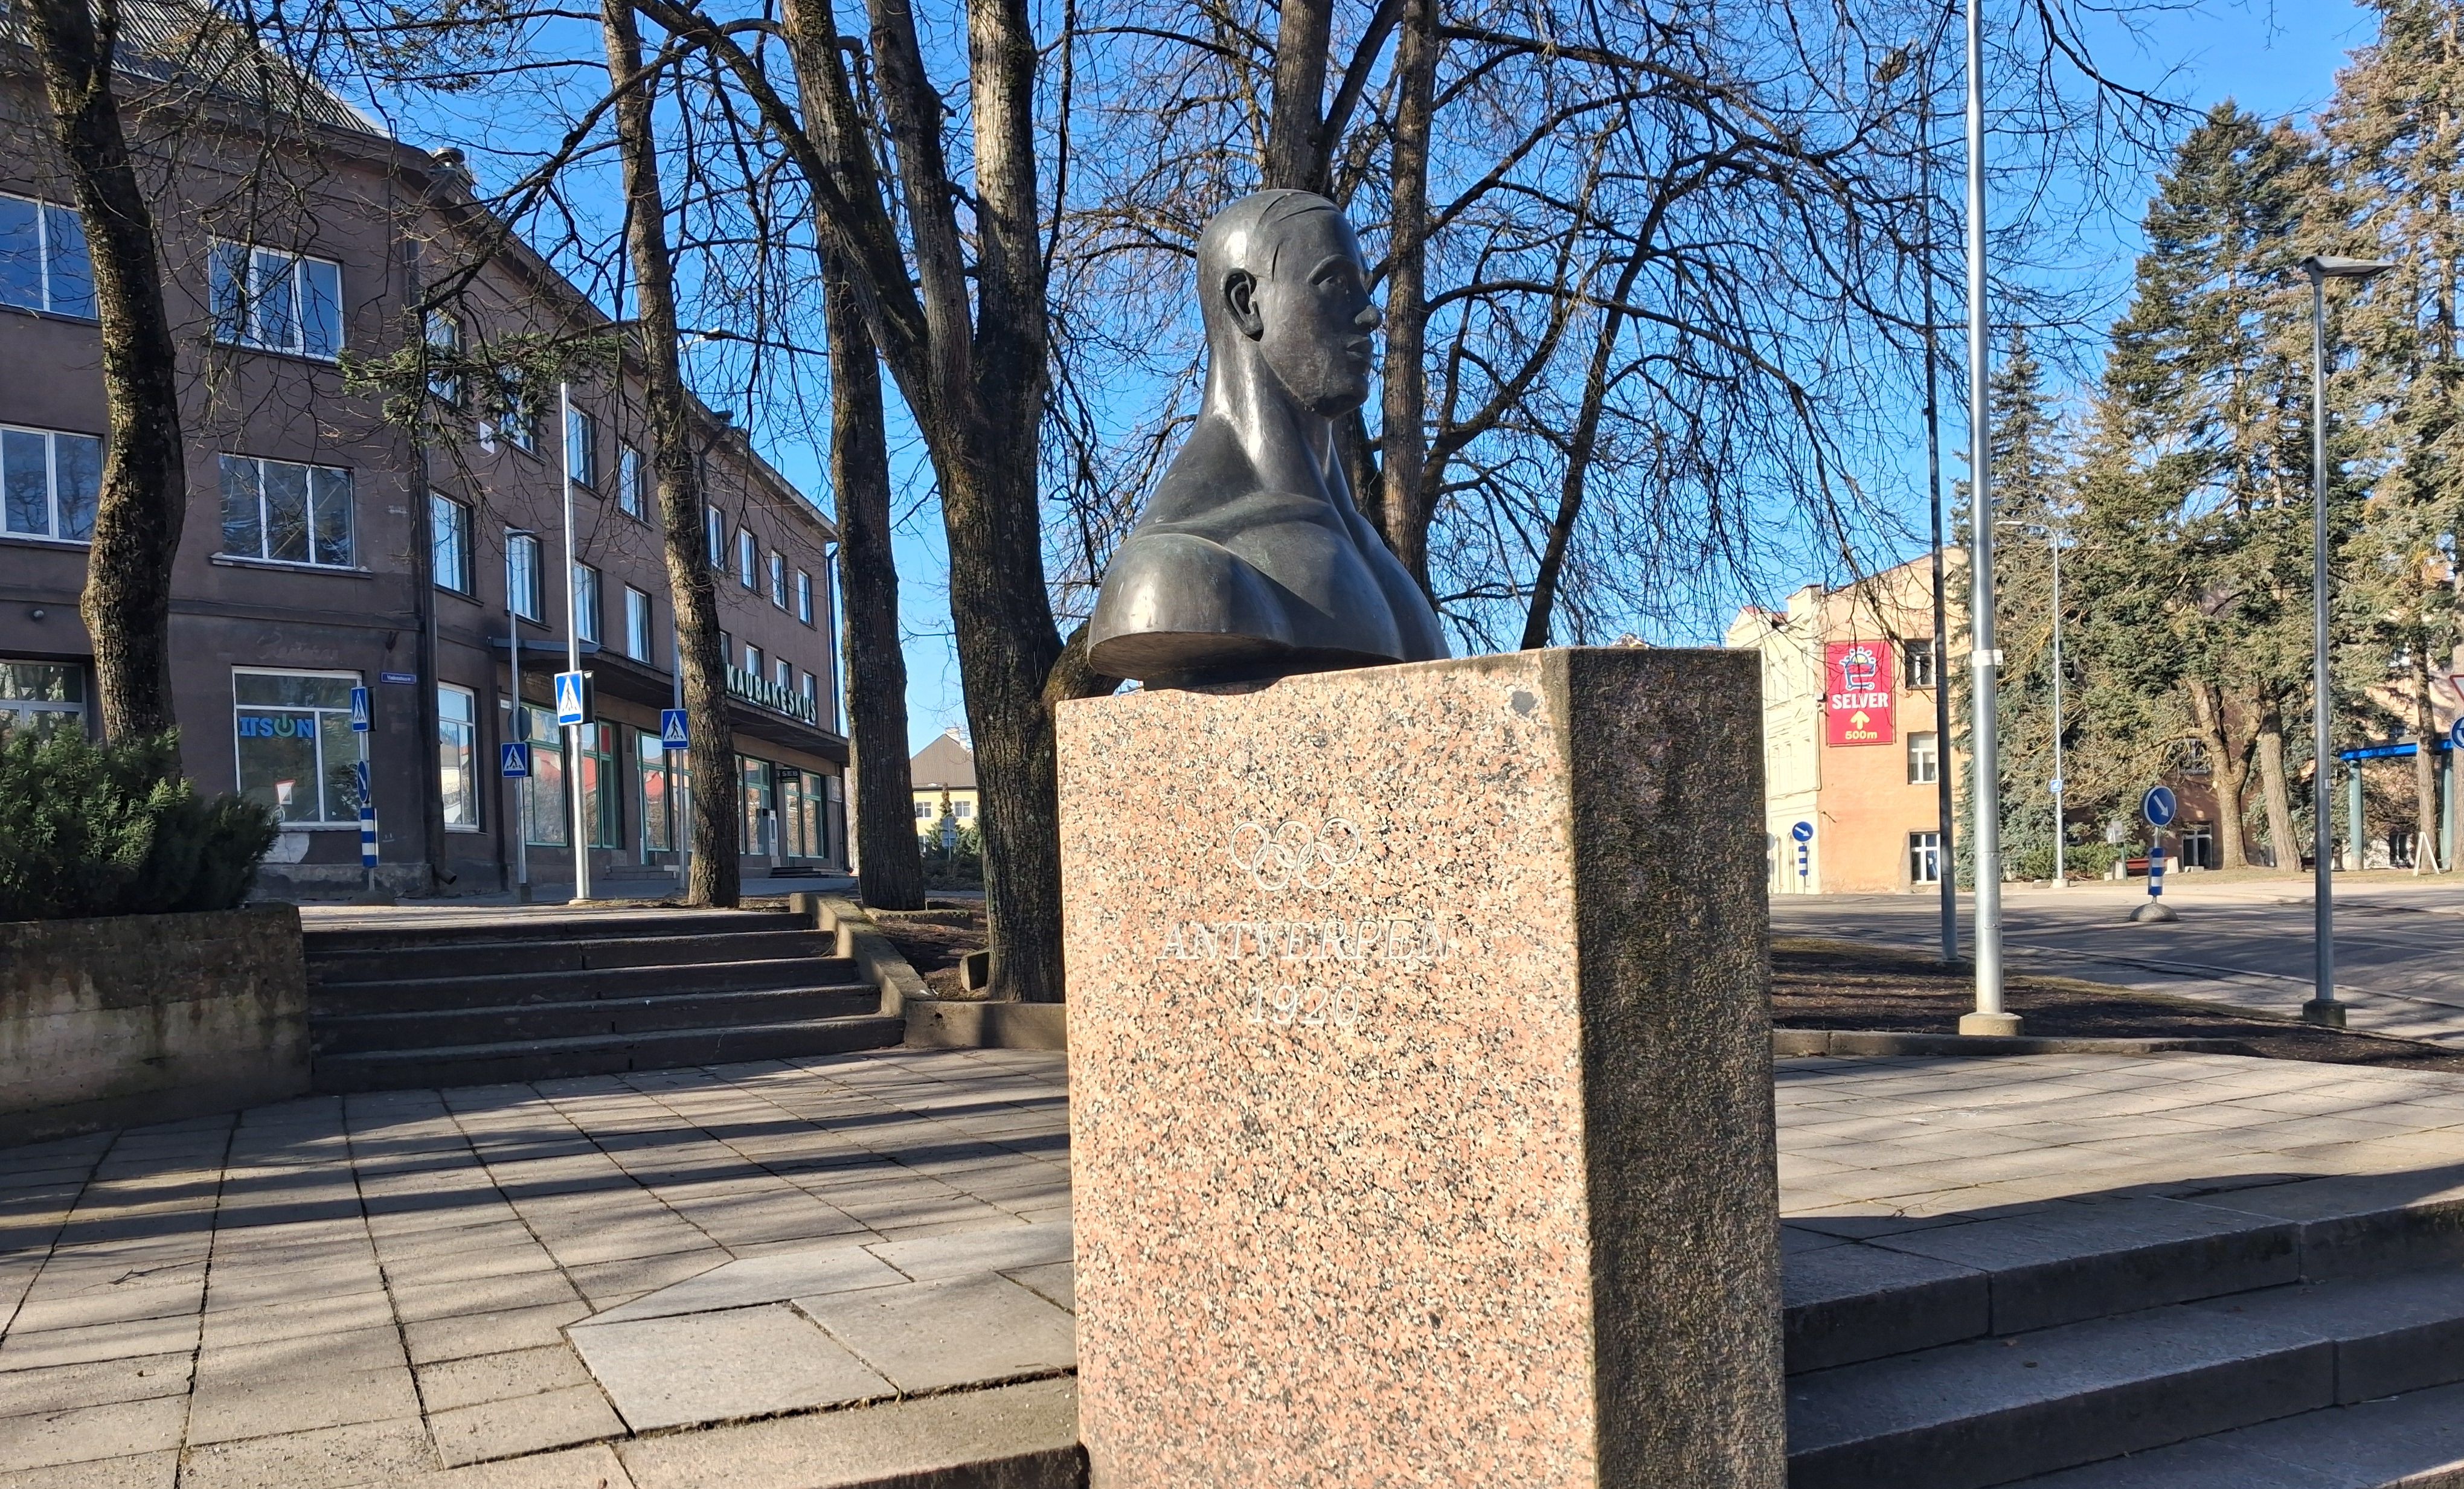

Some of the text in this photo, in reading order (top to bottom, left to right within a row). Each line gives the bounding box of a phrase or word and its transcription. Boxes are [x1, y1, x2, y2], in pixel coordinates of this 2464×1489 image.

[727, 664, 816, 722] KAUBAKESKUS
[1831, 692, 1888, 709] SELVER
[239, 714, 313, 738] ITSON
[1845, 730, 1878, 740] 500m
[1156, 918, 1456, 961] ANTVERPEN
[1248, 984, 1360, 1026] 1920
